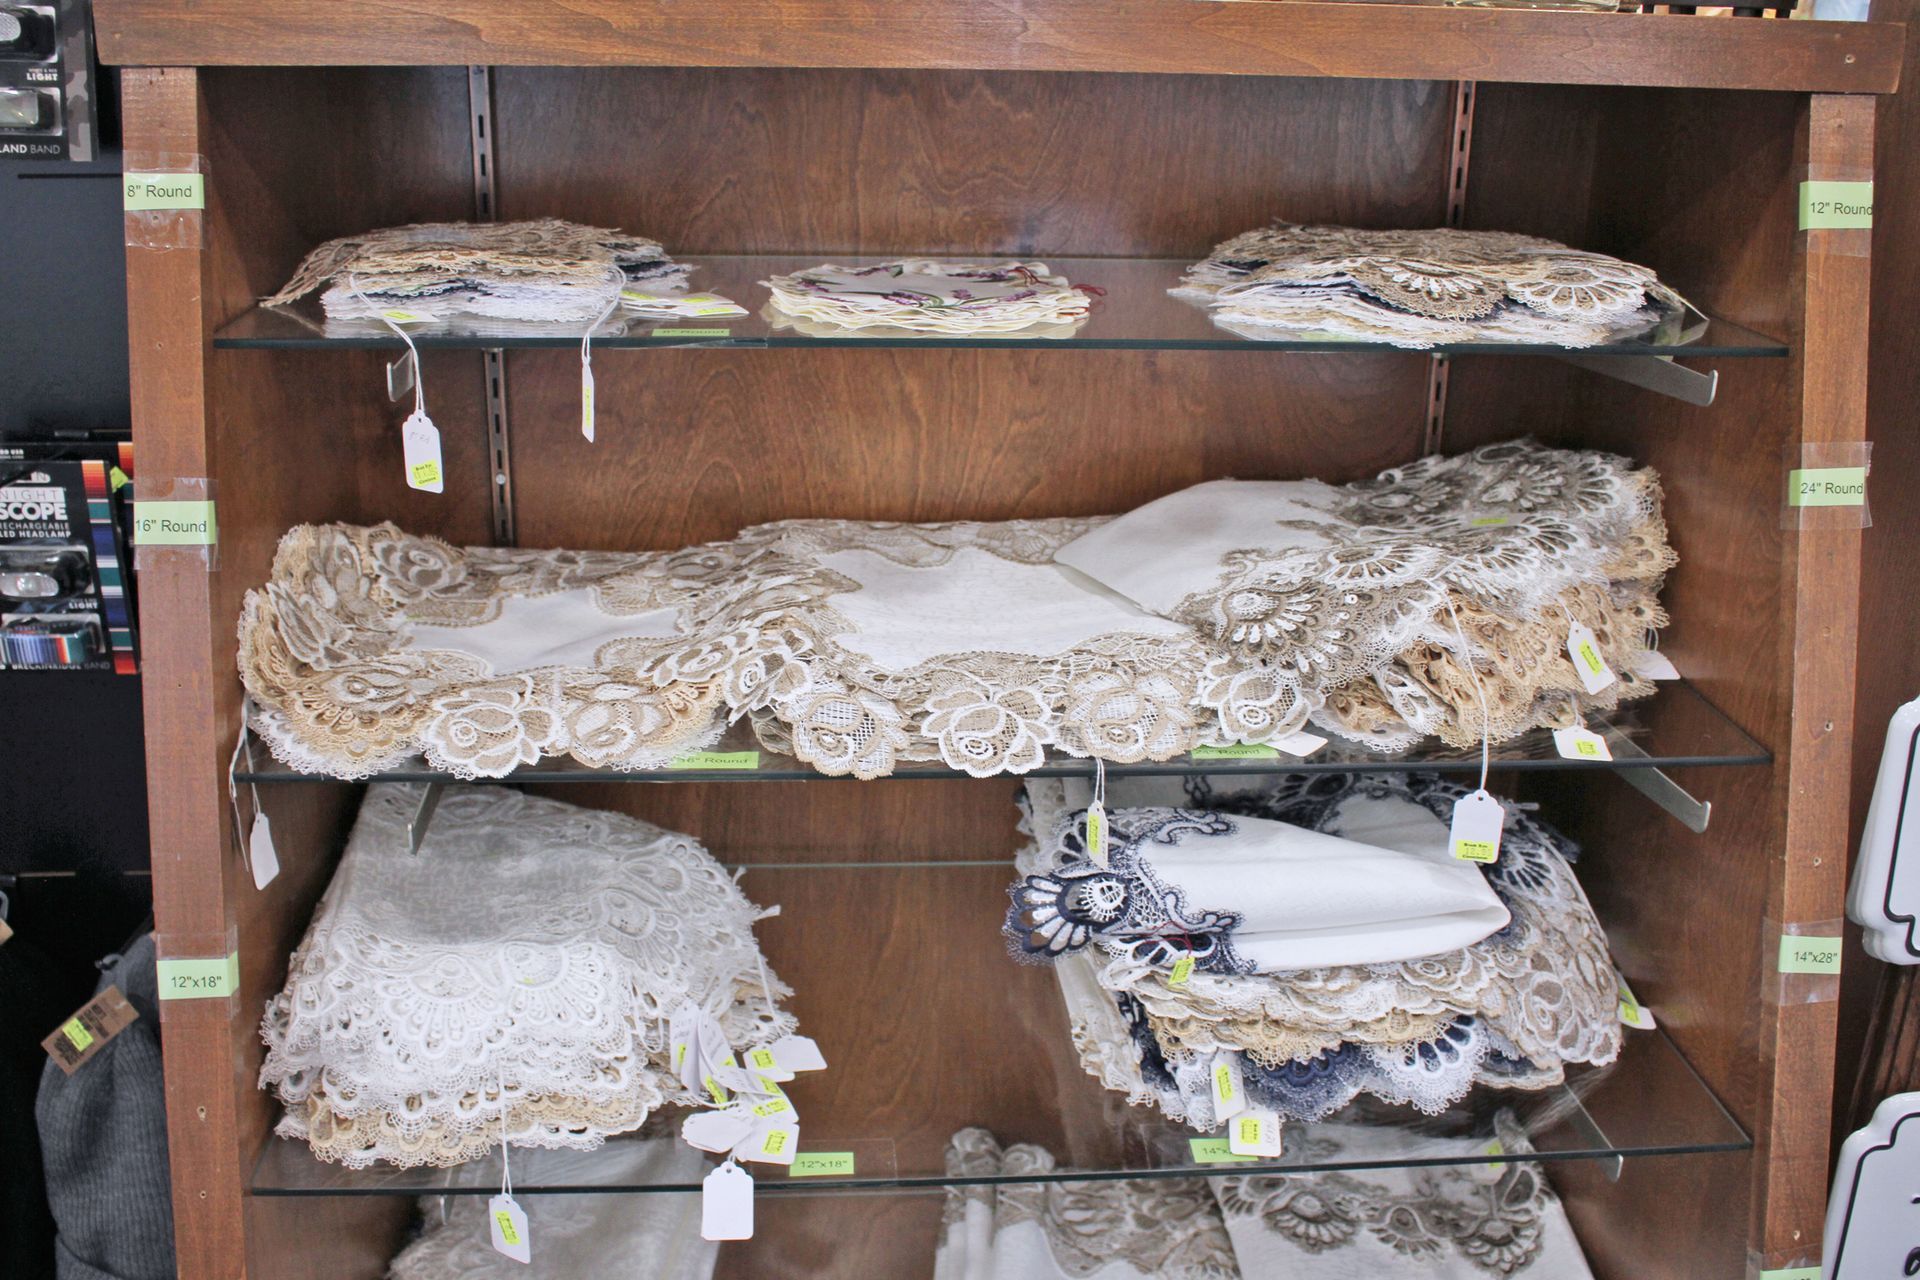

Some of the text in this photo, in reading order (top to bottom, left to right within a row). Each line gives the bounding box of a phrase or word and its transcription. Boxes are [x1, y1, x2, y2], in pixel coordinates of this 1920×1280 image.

[26, 72, 58, 81] LIGHT
[0, 144, 60, 154] AND BAND
[127, 184, 192, 198] 8" Round
[1811, 202, 1873, 216] 12" Round
[1800, 482, 1864, 495] 24" Round
[0, 489, 58, 501] NIGHT
[0, 502, 69, 521] SCOPE
[135, 519, 207, 533] 16" Round
[0, 530, 71, 539] LED HEADLAMP
[1794, 951, 1838, 964] 14"x28"
[171, 976, 222, 988] 12"x18"
[800, 1160, 848, 1169] 12"x18"
